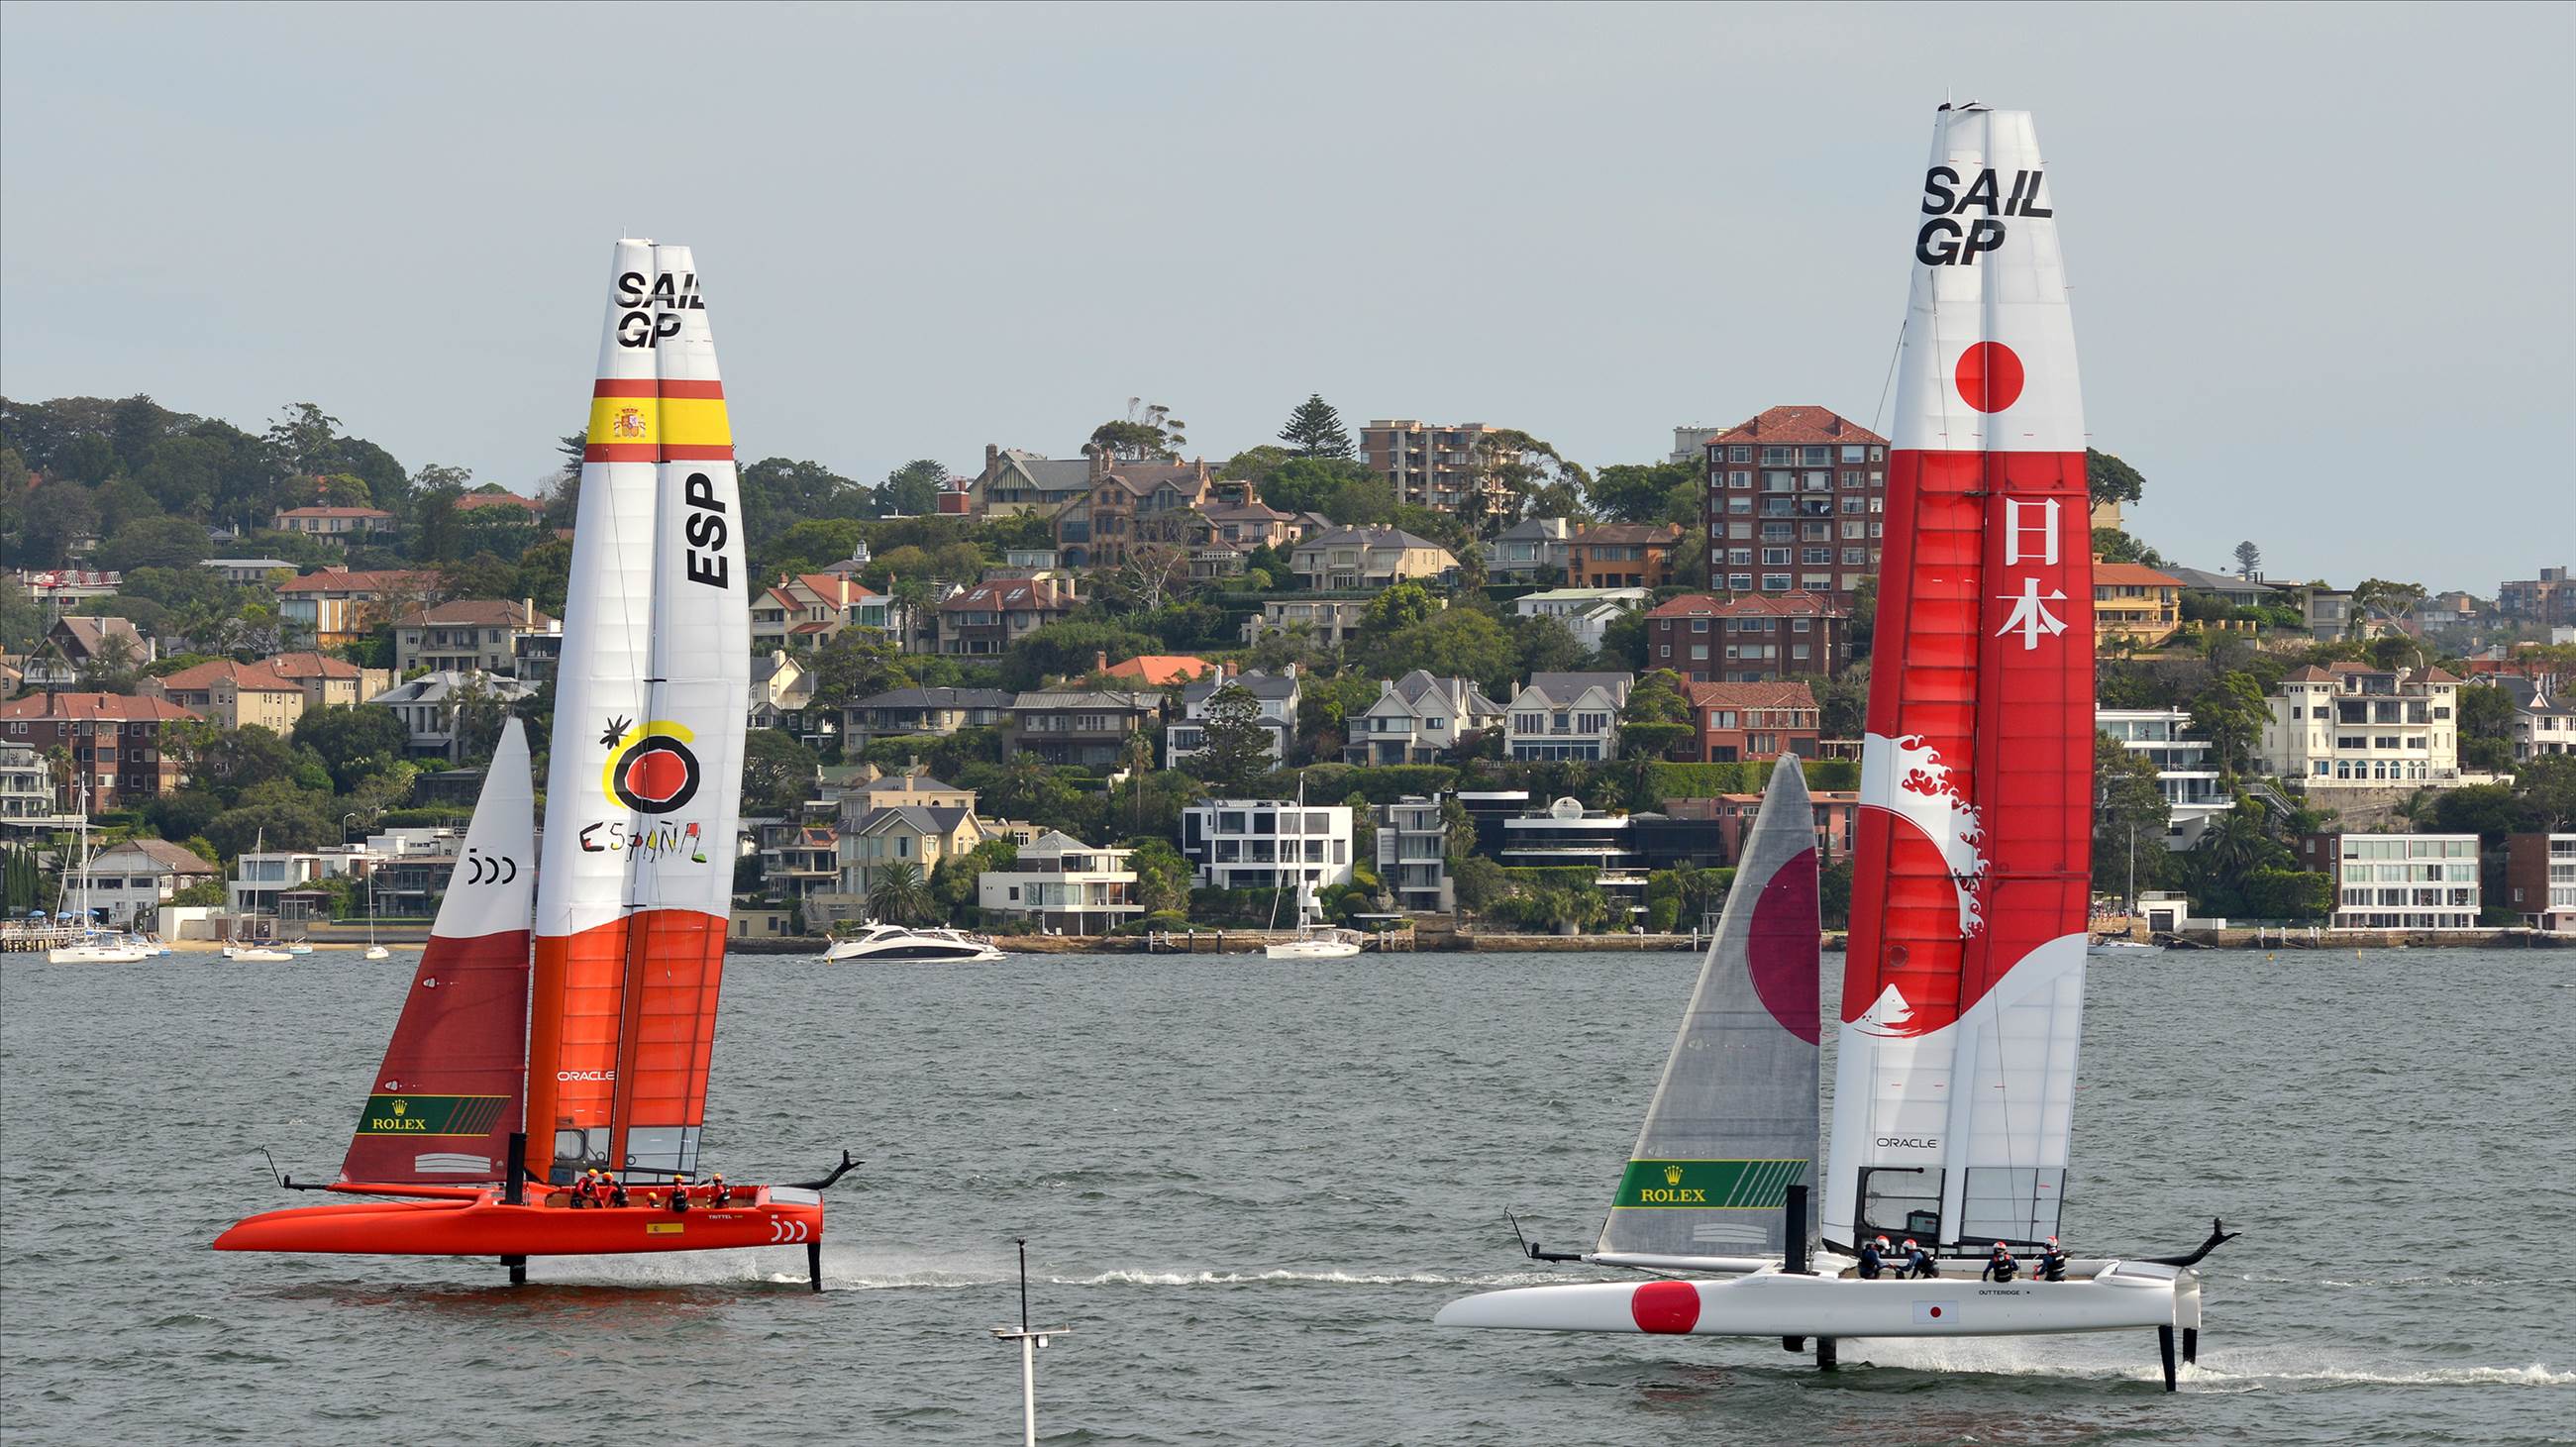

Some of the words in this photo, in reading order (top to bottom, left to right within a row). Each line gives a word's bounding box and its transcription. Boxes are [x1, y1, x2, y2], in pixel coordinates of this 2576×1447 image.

[1921, 165, 2053, 219] SAIL
[1915, 217, 2008, 266] GP
[614, 271, 705, 310] SAIL
[616, 310, 683, 349] GP
[685, 472, 728, 589] ESP
[1995, 497, 2068, 650] 日本
[557, 1070, 616, 1083] ORACLE
[371, 1118, 427, 1130] ROLEX
[1877, 1137, 1937, 1149] ORACLE
[1640, 1189, 1706, 1202] ROLEX
